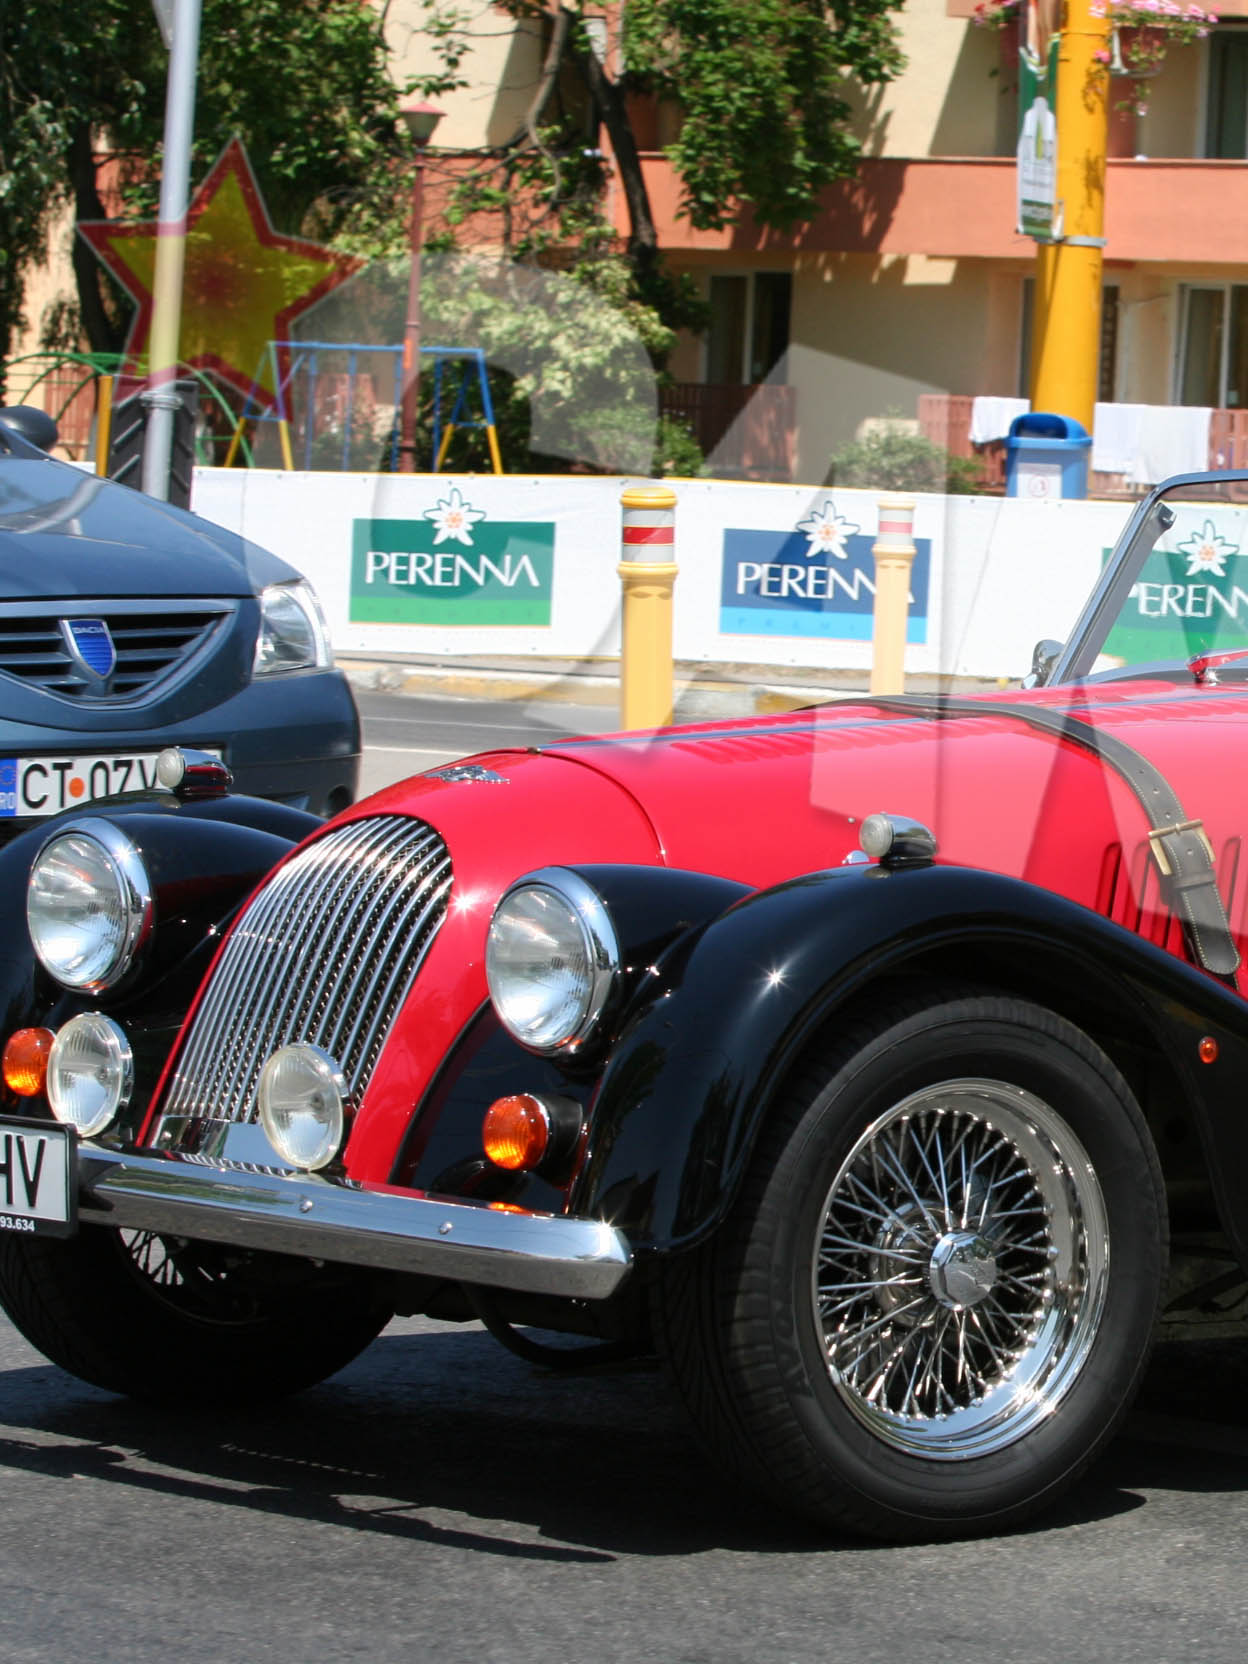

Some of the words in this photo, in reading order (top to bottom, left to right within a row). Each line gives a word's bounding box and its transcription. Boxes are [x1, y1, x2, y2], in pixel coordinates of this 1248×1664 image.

[365, 551, 540, 587] PERENNA
[736, 561, 915, 604] PERENN
[23, 762, 73, 809] CT
